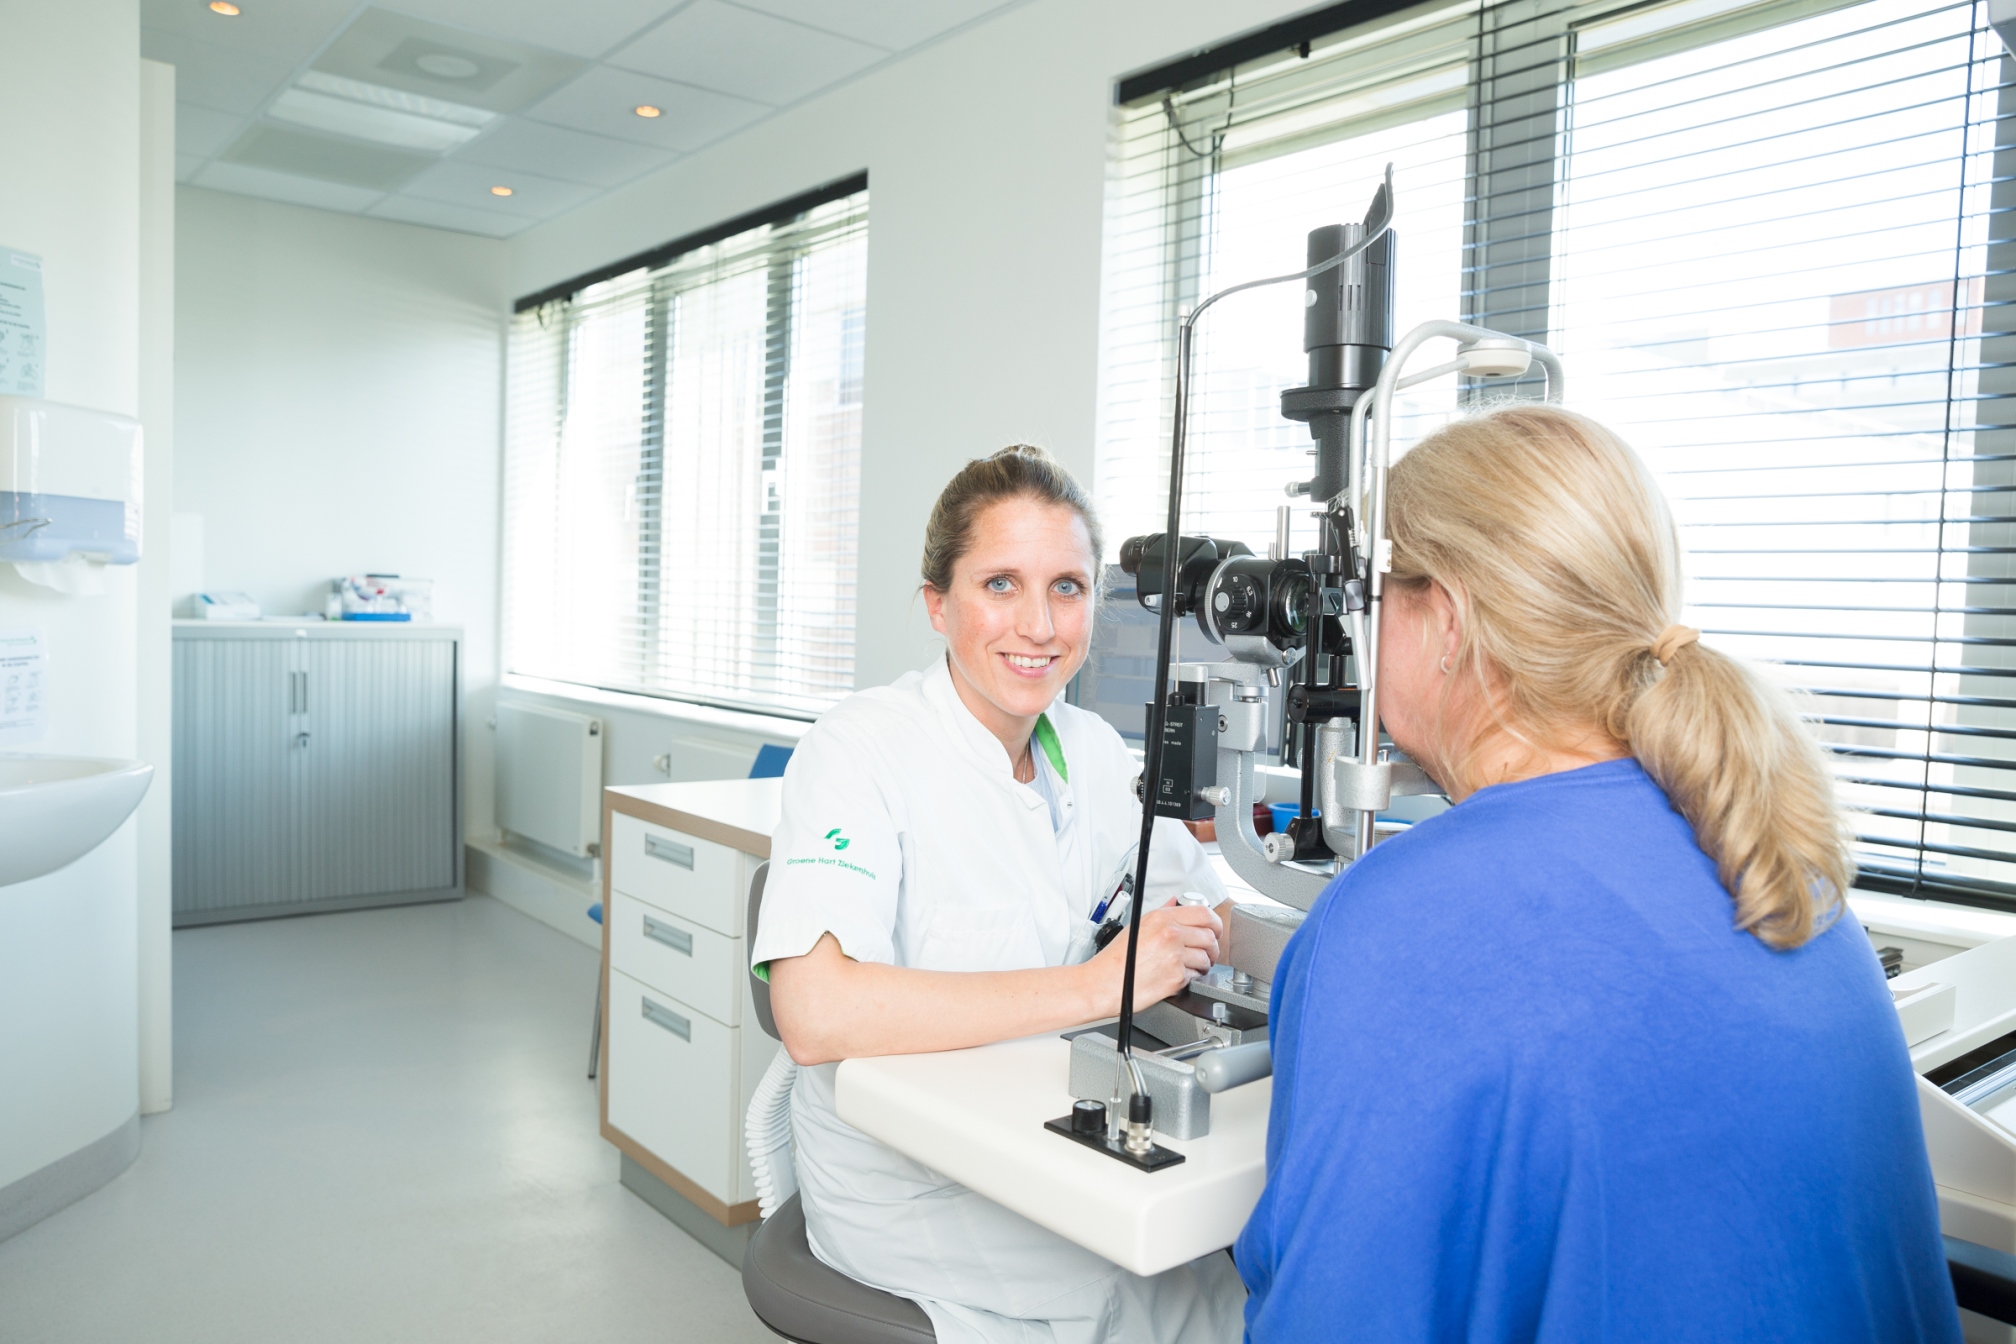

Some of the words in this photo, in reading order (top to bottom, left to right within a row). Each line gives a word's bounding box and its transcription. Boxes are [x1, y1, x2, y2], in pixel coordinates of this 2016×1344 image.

[786, 857, 816, 866] Groene
[817, 856, 836, 866] Hart
[837, 858, 877, 881] Ziekenhuis
